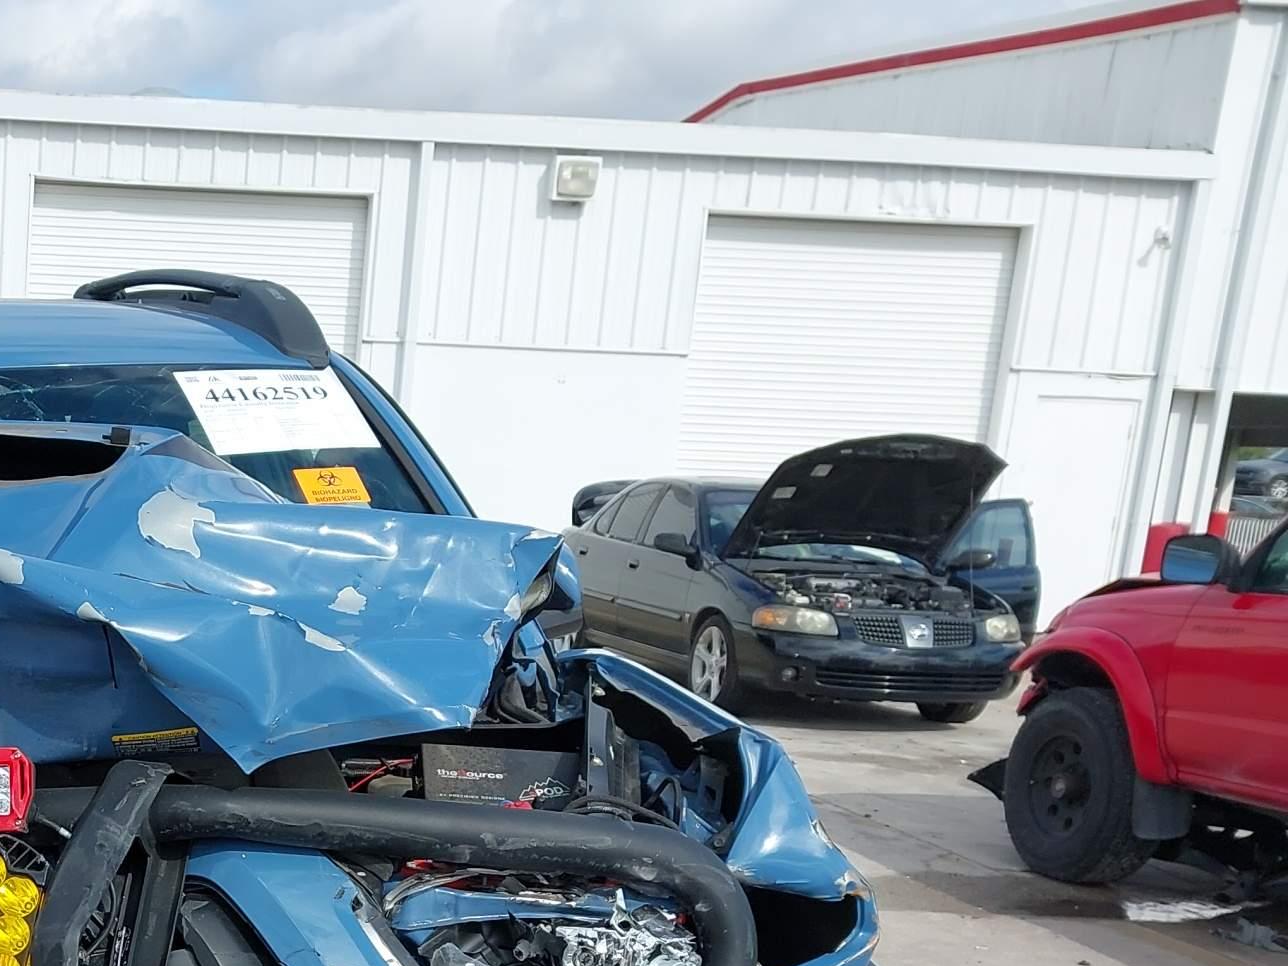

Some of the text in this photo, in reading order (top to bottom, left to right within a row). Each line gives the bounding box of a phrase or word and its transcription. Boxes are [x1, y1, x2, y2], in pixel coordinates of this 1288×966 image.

[205, 386, 328, 402] 44162519
[312, 488, 358, 496] BIOHAZARD
[315, 495, 361, 503] BIOPELIGRO
